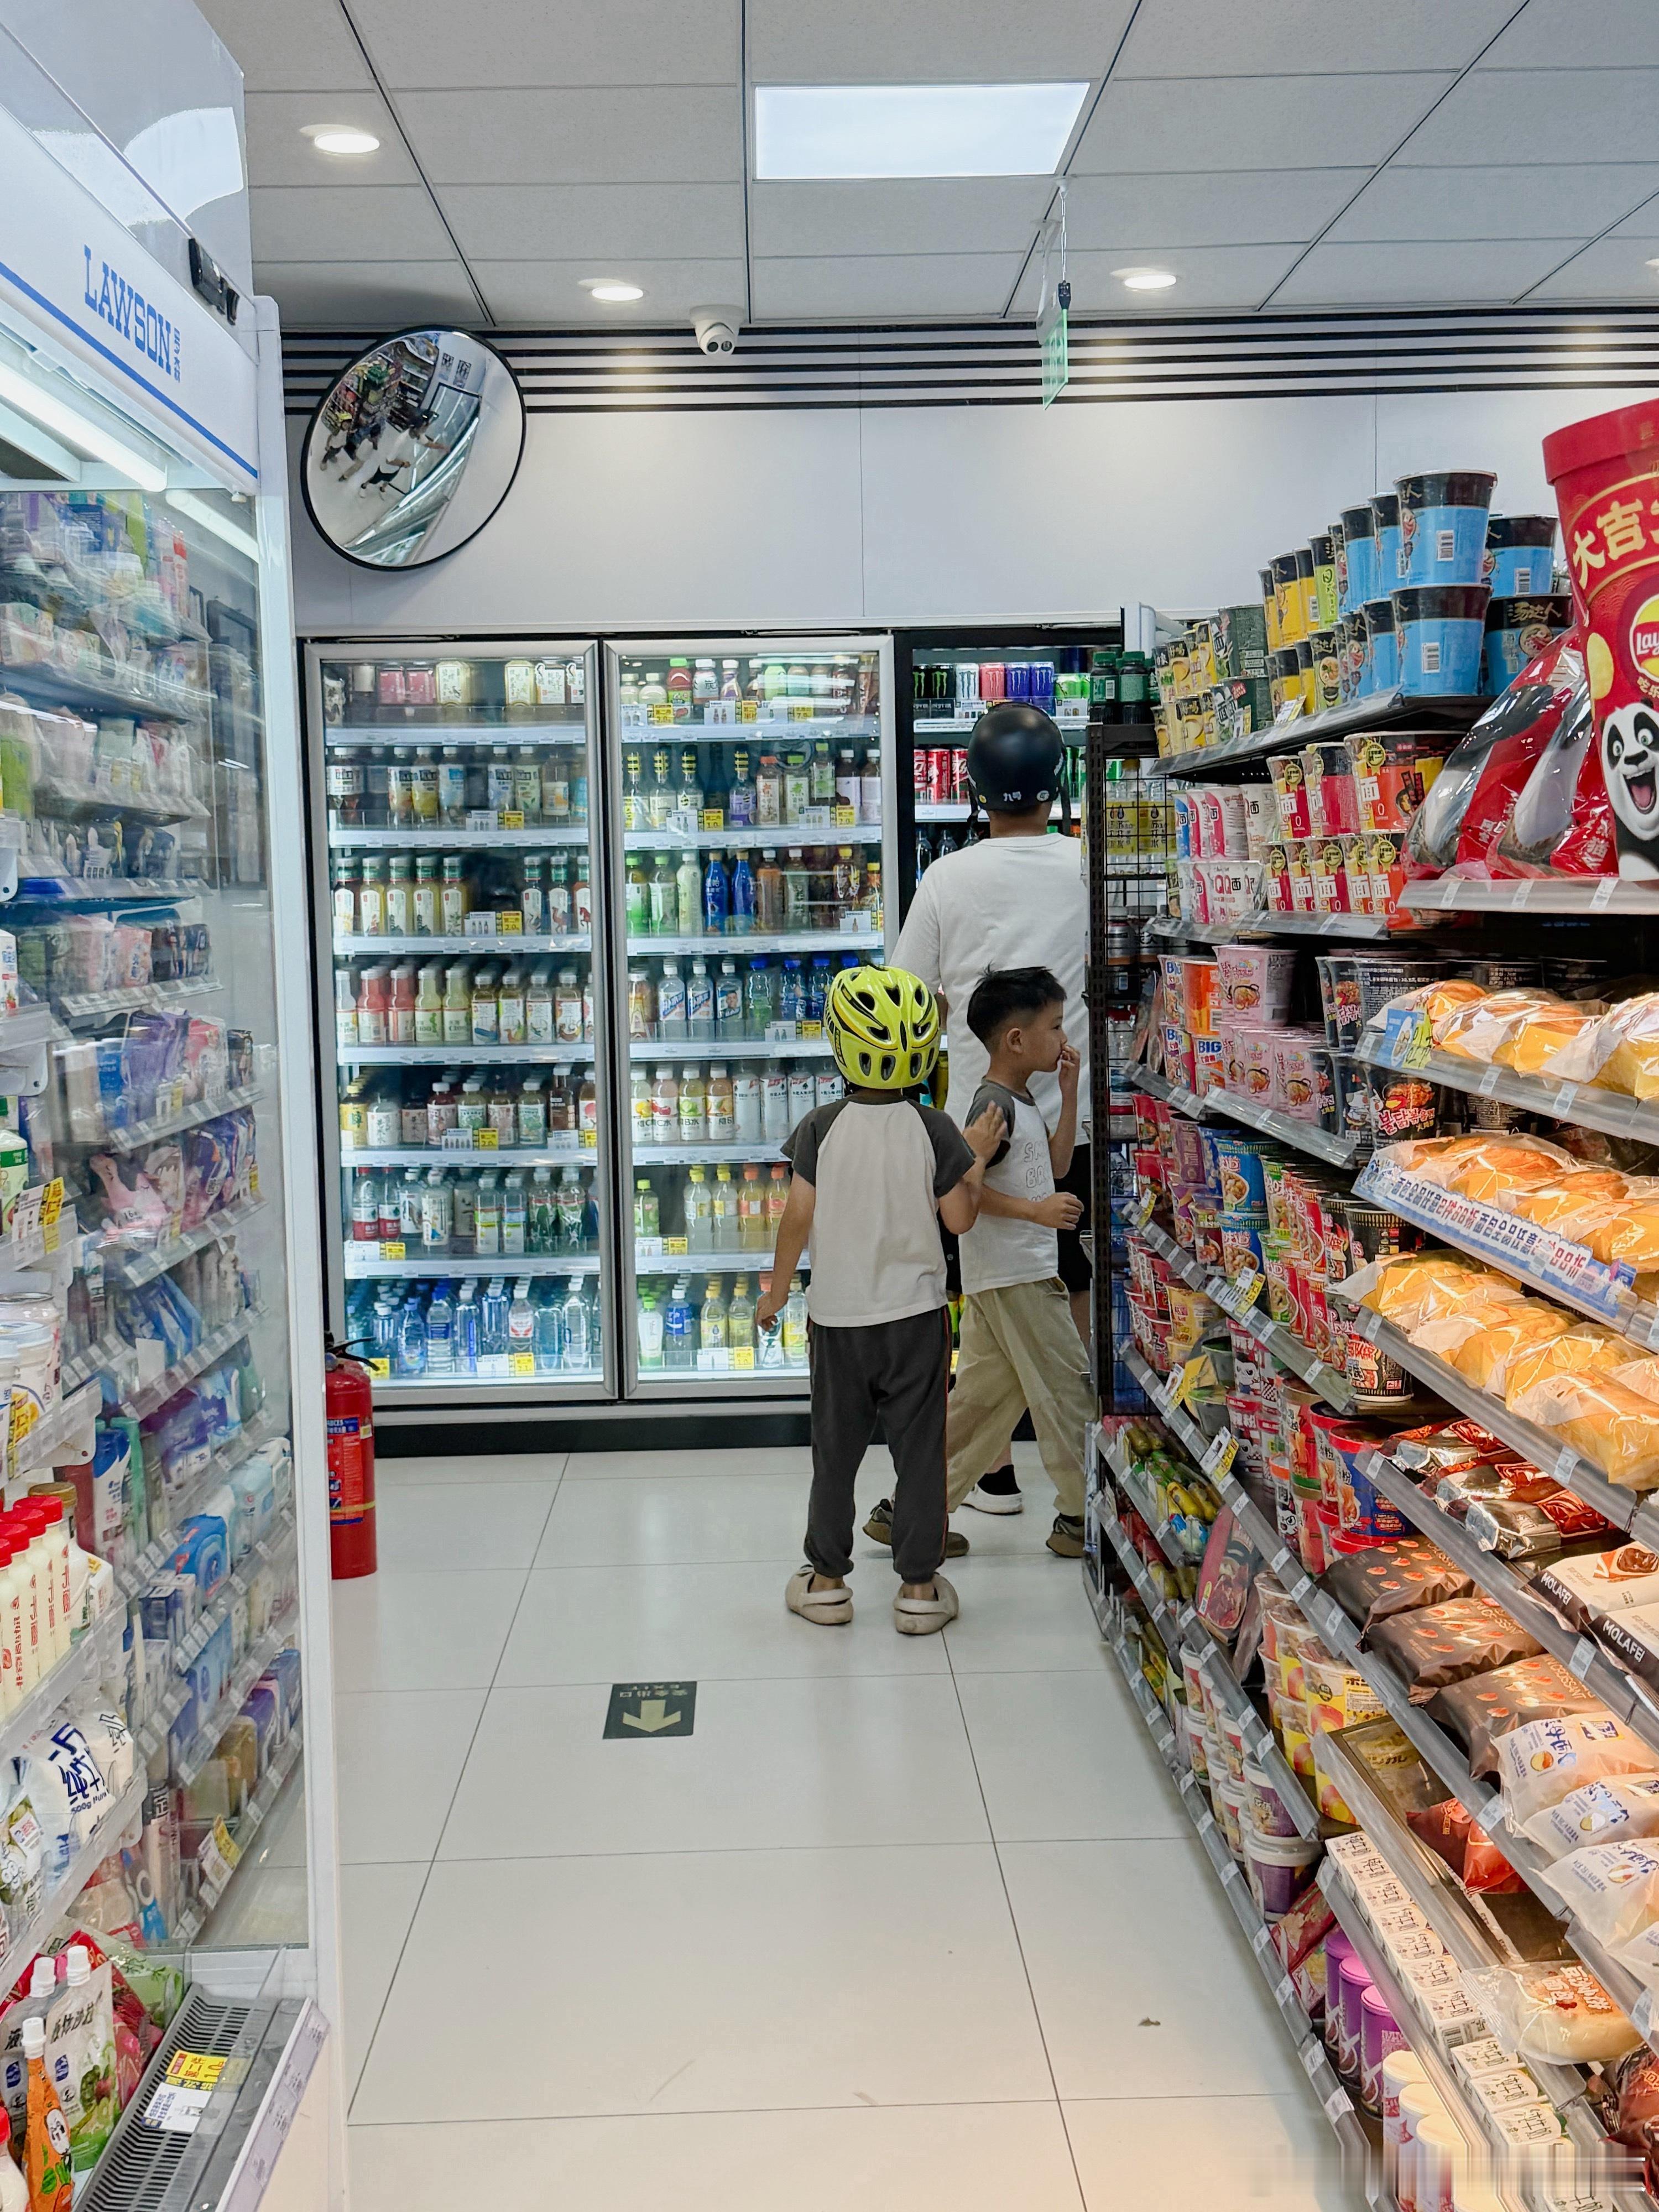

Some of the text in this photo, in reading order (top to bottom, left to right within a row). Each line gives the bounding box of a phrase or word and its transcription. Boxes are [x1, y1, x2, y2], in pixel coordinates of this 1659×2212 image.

[84, 244, 171, 375] LAWSON
[1573, 499, 1659, 589] 大吉
[1636, 632, 1659, 655] Lay
[1198, 1041, 1222, 1053] BIG
[1541, 1572, 1573, 1606] MOLAFEI
[1603, 1620, 1645, 1663] MOLAFEI
[71, 1802, 92, 1814] 500g
